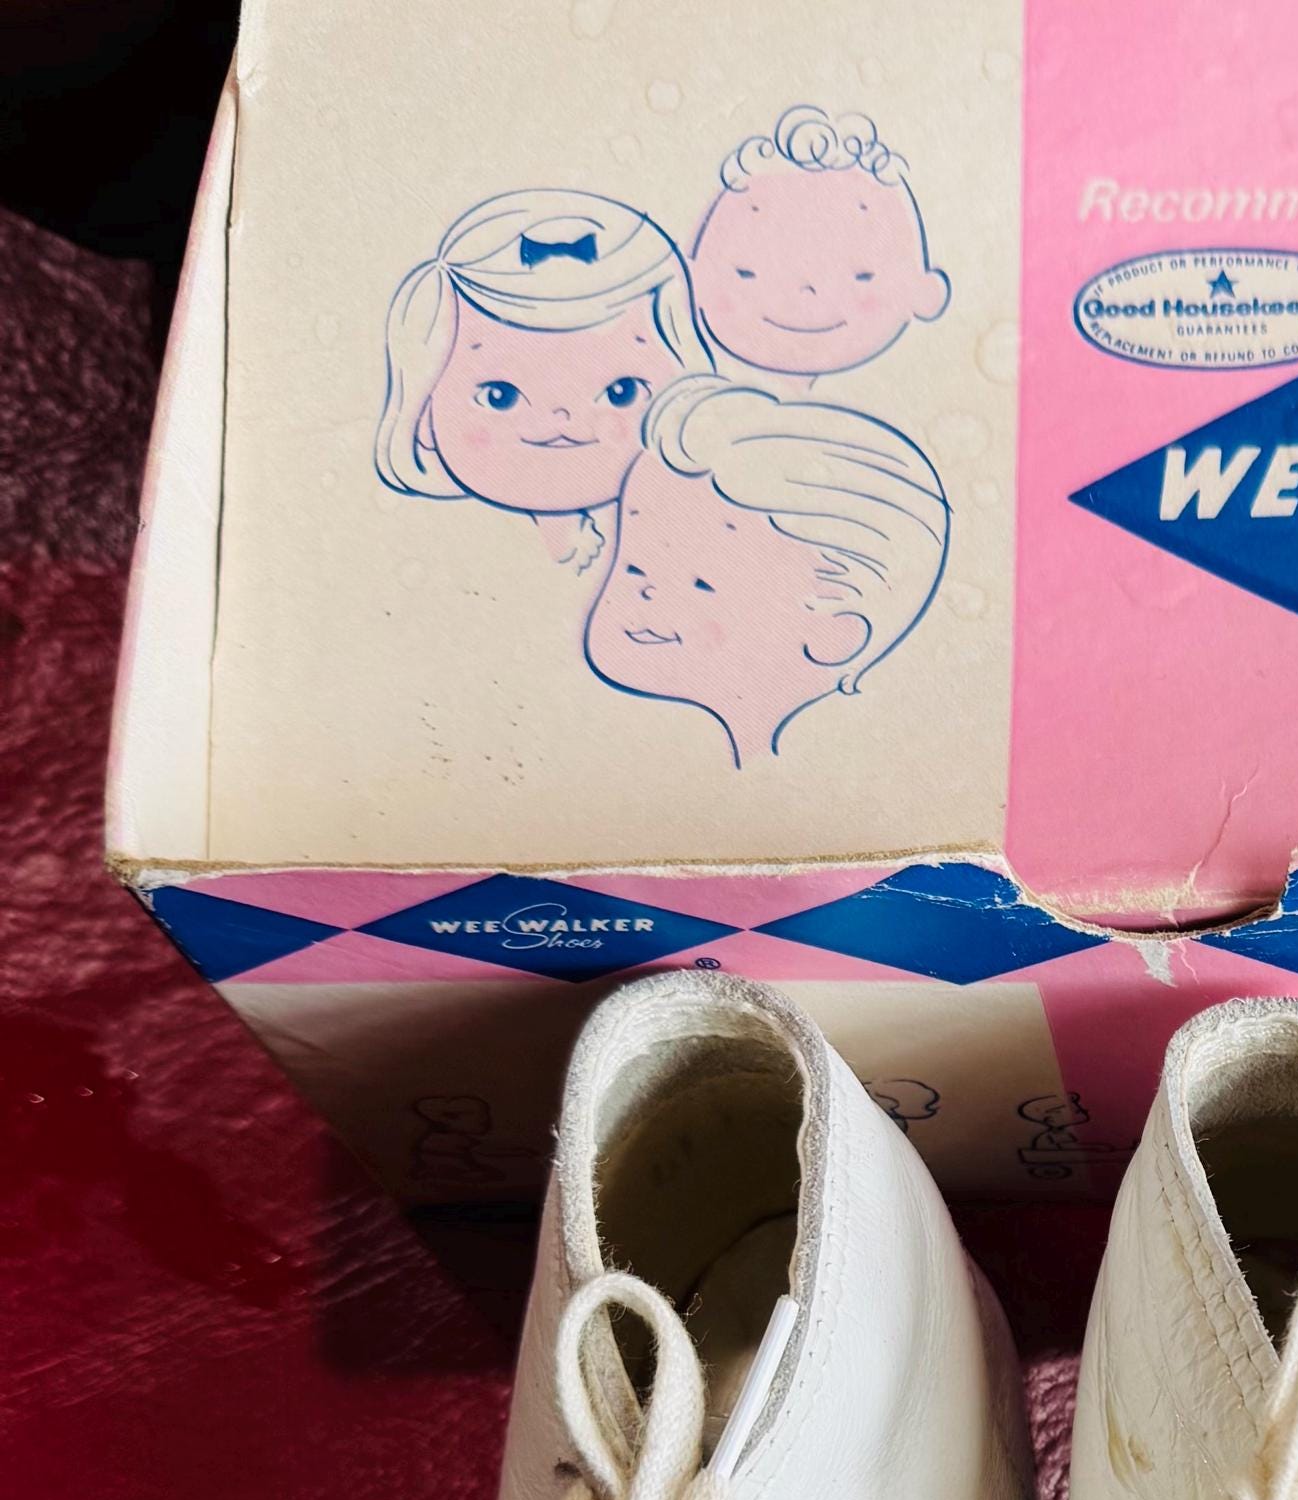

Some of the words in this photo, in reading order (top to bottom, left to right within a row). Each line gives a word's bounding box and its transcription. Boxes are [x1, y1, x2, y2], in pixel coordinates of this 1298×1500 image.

[1108, 261, 1163, 287] PRODUCT
[1170, 259, 1186, 269] OR
[1194, 255, 1288, 270] PERFORMANCE
[1083, 299, 1156, 318] Good
[1090, 321, 1172, 360] REPLACEMENT
[1181, 351, 1196, 361] OR
[1205, 351, 1254, 361] REFUND
[1262, 348, 1275, 359] TO
[1177, 323, 1267, 336] GUARANTEES
[430, 920, 500, 934] WEE
[517, 918, 654, 932] WALKER
[501, 903, 604, 949] Shoes
